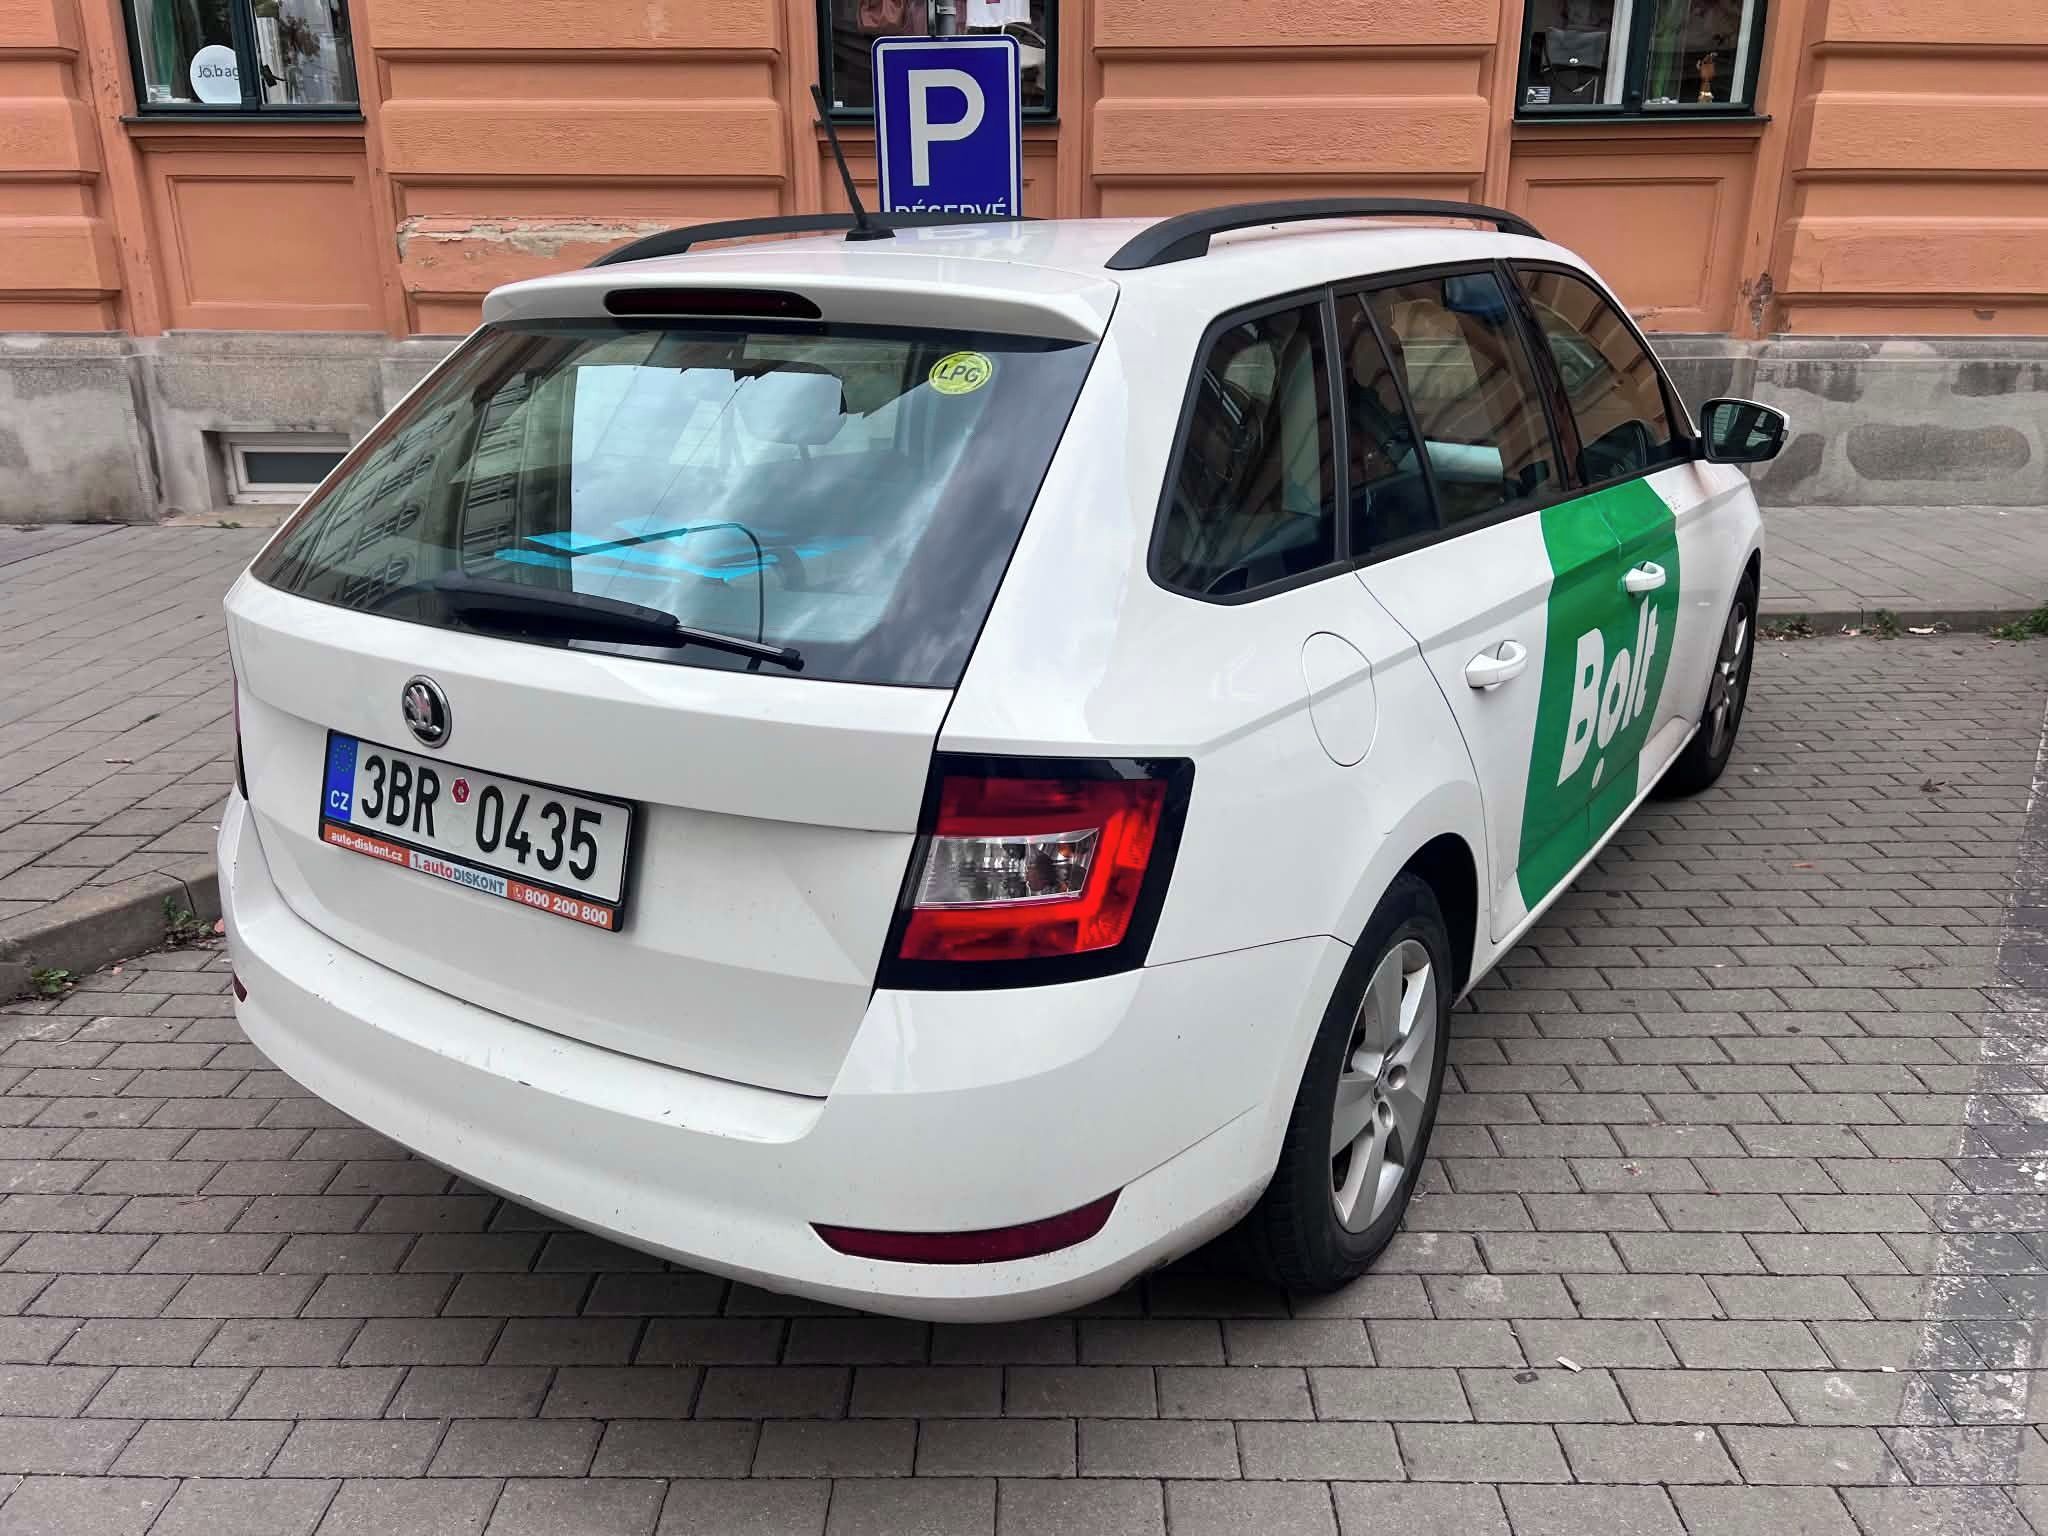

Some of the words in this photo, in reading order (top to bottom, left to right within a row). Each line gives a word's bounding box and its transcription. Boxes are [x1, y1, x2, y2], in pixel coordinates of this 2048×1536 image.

[908, 68, 985, 187] P
[937, 363, 982, 383] LPG
[1557, 595, 1658, 789] Bolt
[330, 789, 350, 811] CZ
[361, 754, 440, 838] 3BR
[475, 785, 602, 881] 0435
[331, 831, 404, 862] auto-diskont.cz
[524, 888, 550, 908] 800
[552, 897, 578, 917] 200
[581, 905, 608, 925] 800
